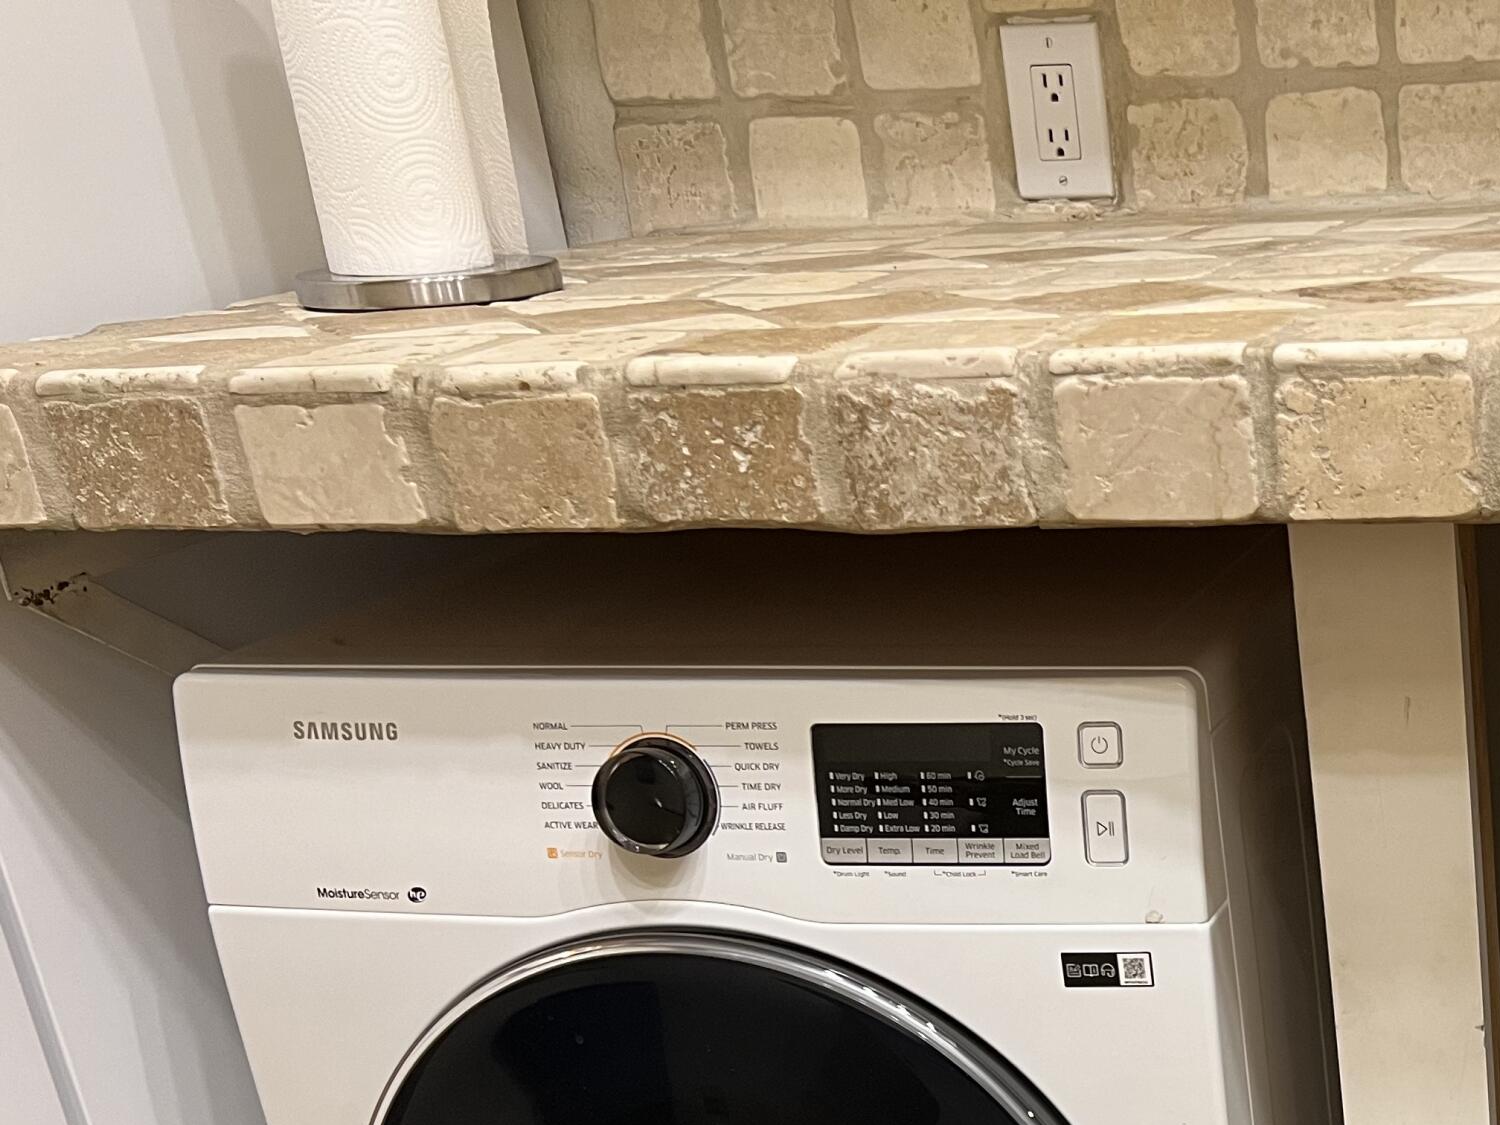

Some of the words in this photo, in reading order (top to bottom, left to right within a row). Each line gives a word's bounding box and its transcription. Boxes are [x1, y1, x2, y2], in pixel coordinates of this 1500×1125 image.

[533, 722, 568, 730] NORMAL
[725, 722, 749, 730] PERM
[751, 722, 777, 730] PRESS
[293, 721, 398, 741] SAMSUNG
[535, 742, 562, 750] HEAVY
[564, 742, 586, 750] DUTY
[744, 742, 779, 750] TOWELS
[1003, 747, 1016, 756] My
[1017, 747, 1040, 756] Cycle
[536, 762, 572, 770] SANITIZE
[734, 763, 760, 771] QUICK
[852, 772, 865, 781] Dry
[880, 772, 898, 781] High
[539, 782, 563, 790] WOOL
[741, 783, 762, 791] TIME
[855, 786, 867, 794] Dry
[881, 785, 910, 793] Medium
[938, 785, 953, 793] min
[863, 799, 876, 807] Dry
[1012, 798, 1038, 807] Adjust
[854, 812, 867, 820] Dry
[544, 821, 573, 829] ACTIVE
[574, 821, 599, 829] WEAR
[721, 822, 753, 830] WRINKLE
[755, 822, 785, 831] RELEASE
[861, 825, 873, 833] Dry
[586, 850, 602, 859] Dry
[826, 846, 840, 855] Dry
[842, 846, 864, 854] Level
[926, 847, 944, 855] Time
[727, 853, 756, 861] Manual
[757, 853, 773, 862] Dry
[966, 851, 995, 859] Prevent
[1011, 851, 1030, 859] Load
[1031, 851, 1046, 859] Bell
[317, 887, 399, 900] MoistureSensor
